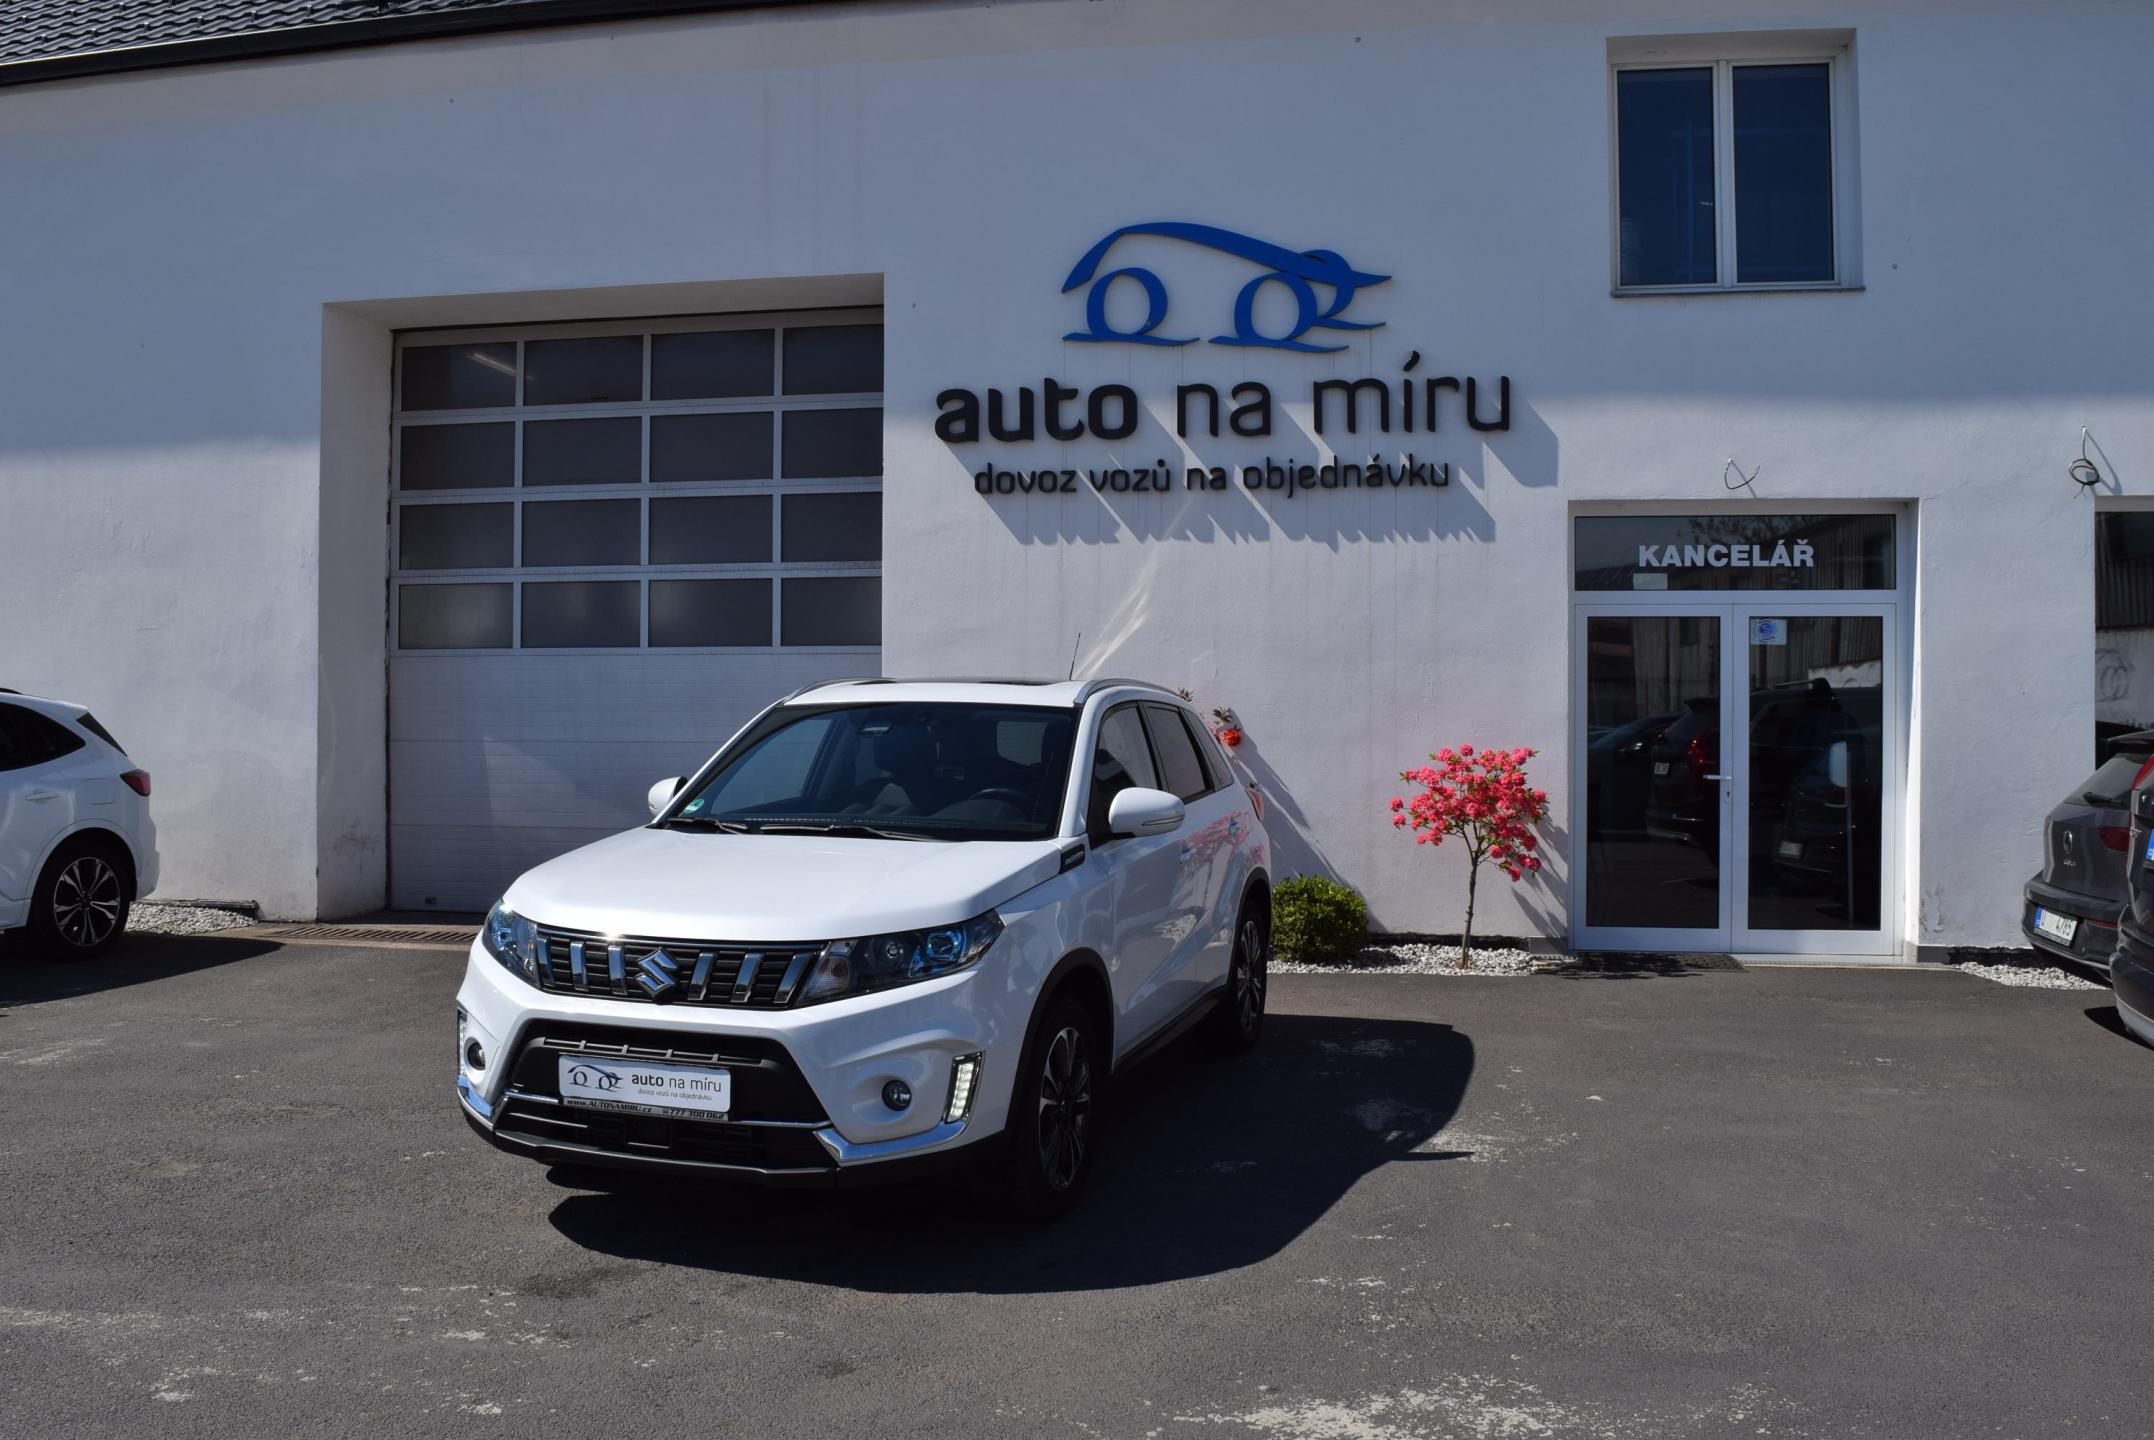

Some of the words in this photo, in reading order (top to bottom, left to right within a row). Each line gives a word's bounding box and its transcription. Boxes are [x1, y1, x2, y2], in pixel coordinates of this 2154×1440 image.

[934, 377, 1139, 443] auto
[1176, 381, 1272, 438] na
[1313, 350, 1511, 434] míru
[974, 462, 1077, 495] dovoz
[1090, 458, 1171, 493] vozů
[1187, 463, 1227, 491] na
[1243, 453, 1449, 498] objednávku
[1638, 538, 1815, 568] KANCELÁŘ
[631, 1073, 664, 1087] auto
[669, 1077, 685, 1089] na
[690, 1077, 721, 1092] míru
[688, 1110, 704, 1118] 300
